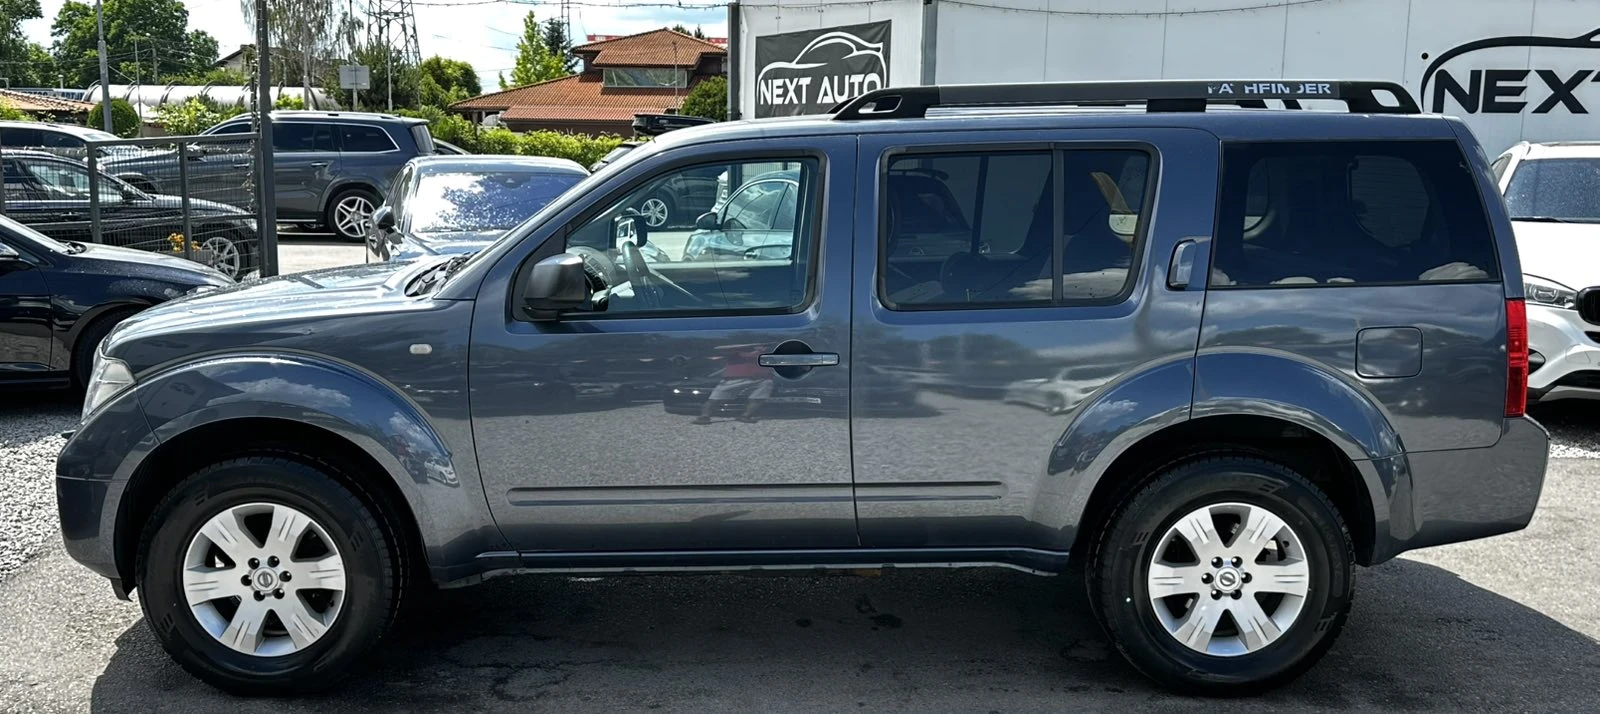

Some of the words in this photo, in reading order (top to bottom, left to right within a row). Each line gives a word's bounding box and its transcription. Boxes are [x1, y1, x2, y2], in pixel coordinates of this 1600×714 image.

[759, 76, 812, 105] NEXT
[816, 72, 882, 104] AUTO
[1432, 68, 1600, 114] NEX
